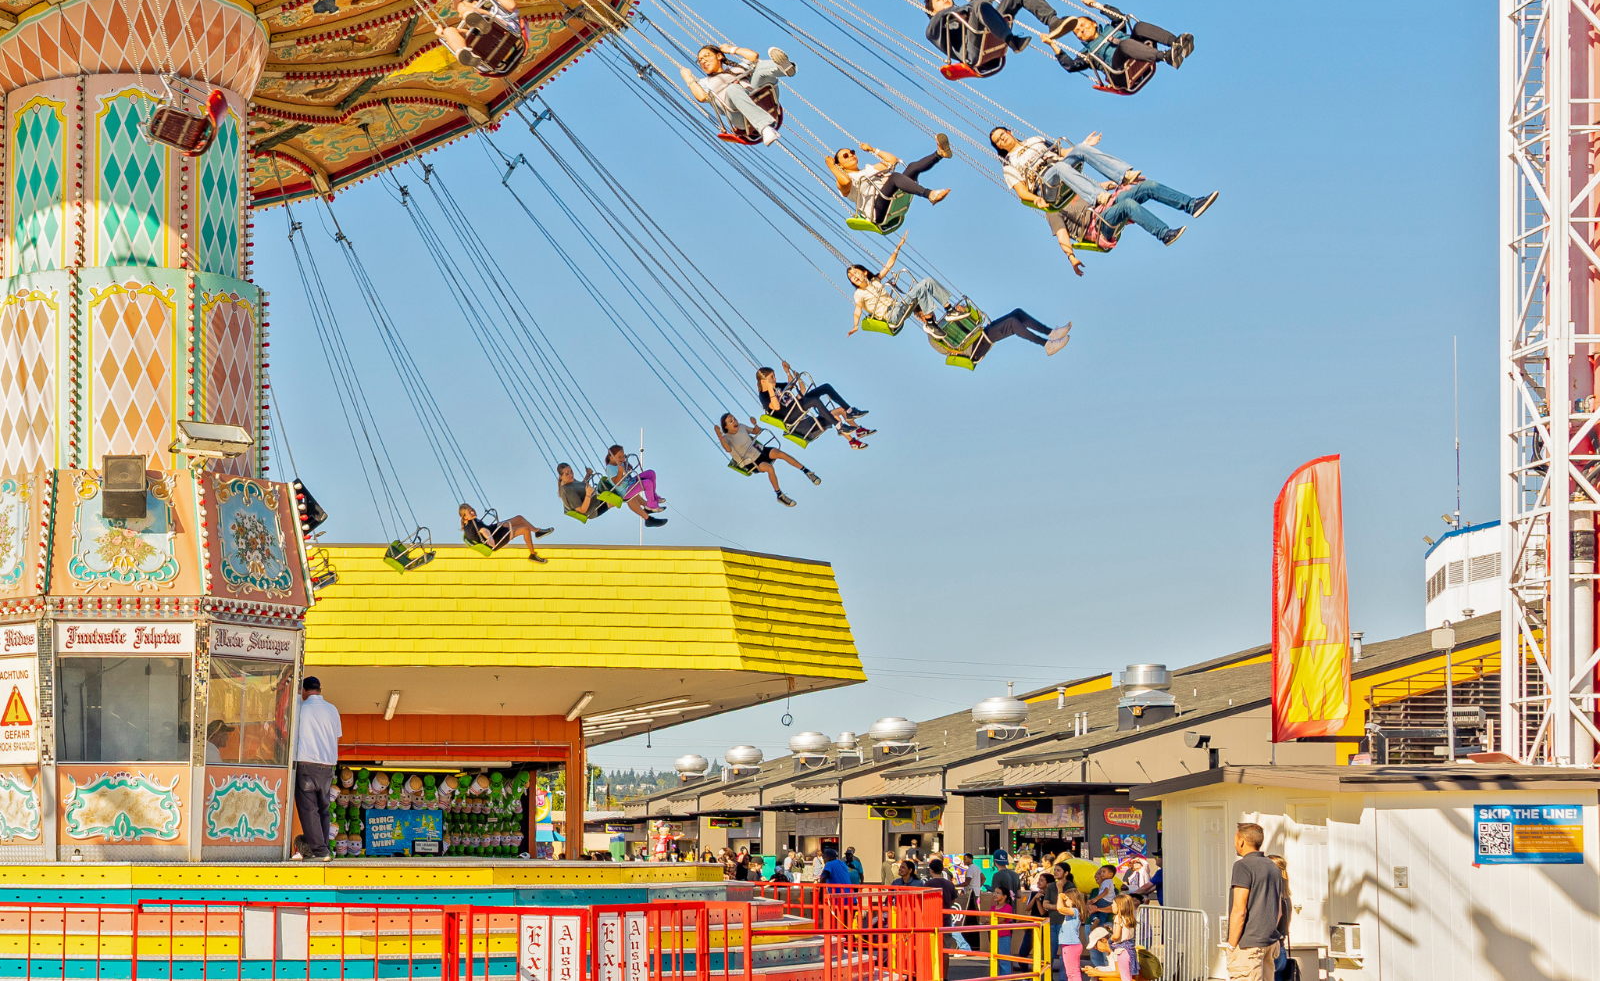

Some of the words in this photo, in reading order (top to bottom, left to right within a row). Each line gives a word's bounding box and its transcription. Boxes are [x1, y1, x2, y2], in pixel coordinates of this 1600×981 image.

[1288, 482, 1349, 723] ATM
[4, 628, 35, 652] Rides
[65, 625, 127, 649] Funtastic
[213, 628, 244, 650] Wave
[246, 630, 291, 656] Swinger
[0, 670, 29, 680] ACHTUNG
[4, 729, 30, 740] GEFAHR
[1479, 808, 1511, 819] SKIP
[1513, 808, 1539, 819] THE
[1542, 808, 1578, 819] LINE!
[368, 816, 394, 824] RING
[371, 824, 393, 832] ONE
